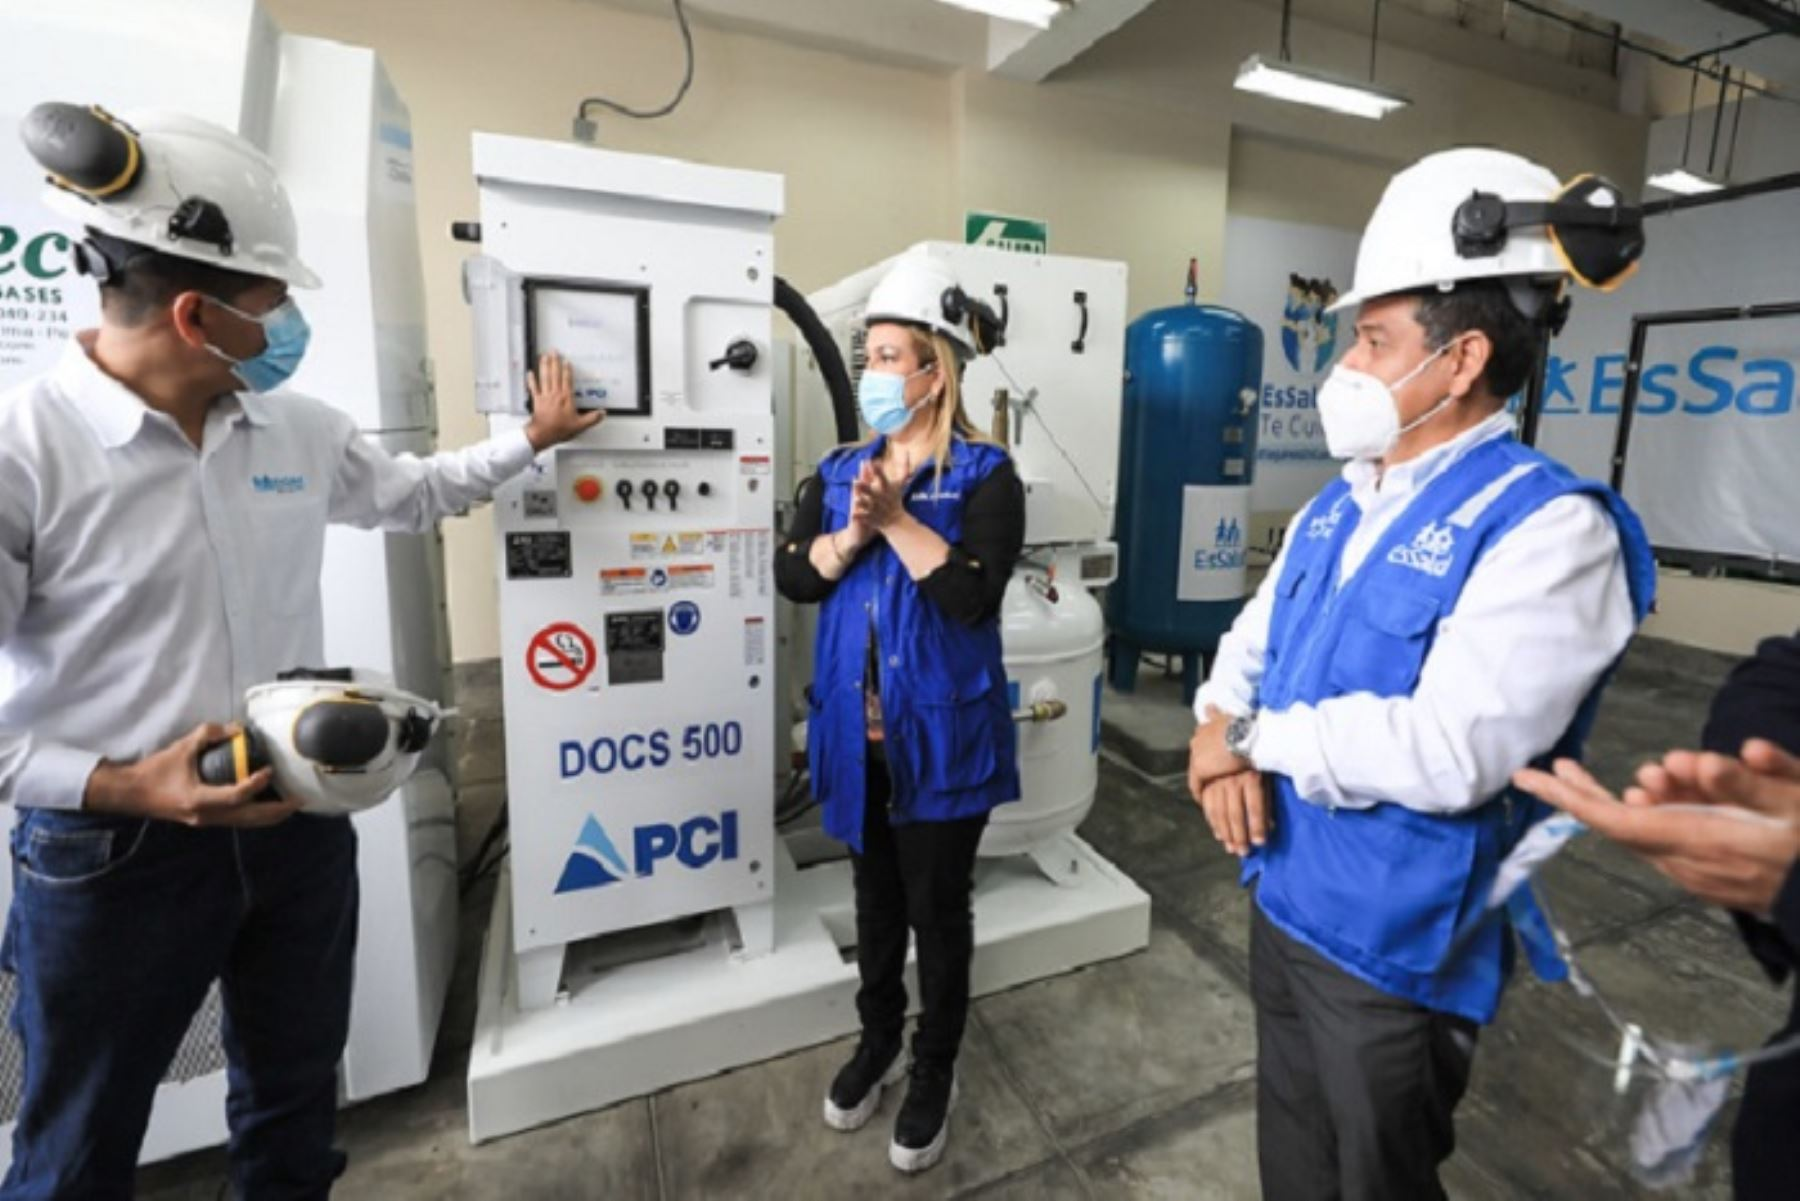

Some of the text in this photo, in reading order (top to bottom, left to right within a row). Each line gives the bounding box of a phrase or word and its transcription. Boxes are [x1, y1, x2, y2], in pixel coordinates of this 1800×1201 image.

[0, 286, 62, 305] ASES
[1589, 346, 1795, 415] EsSa
[1261, 413, 1283, 438] Te
[559, 720, 742, 779] DOCS 500
[633, 809, 739, 878] PCI
